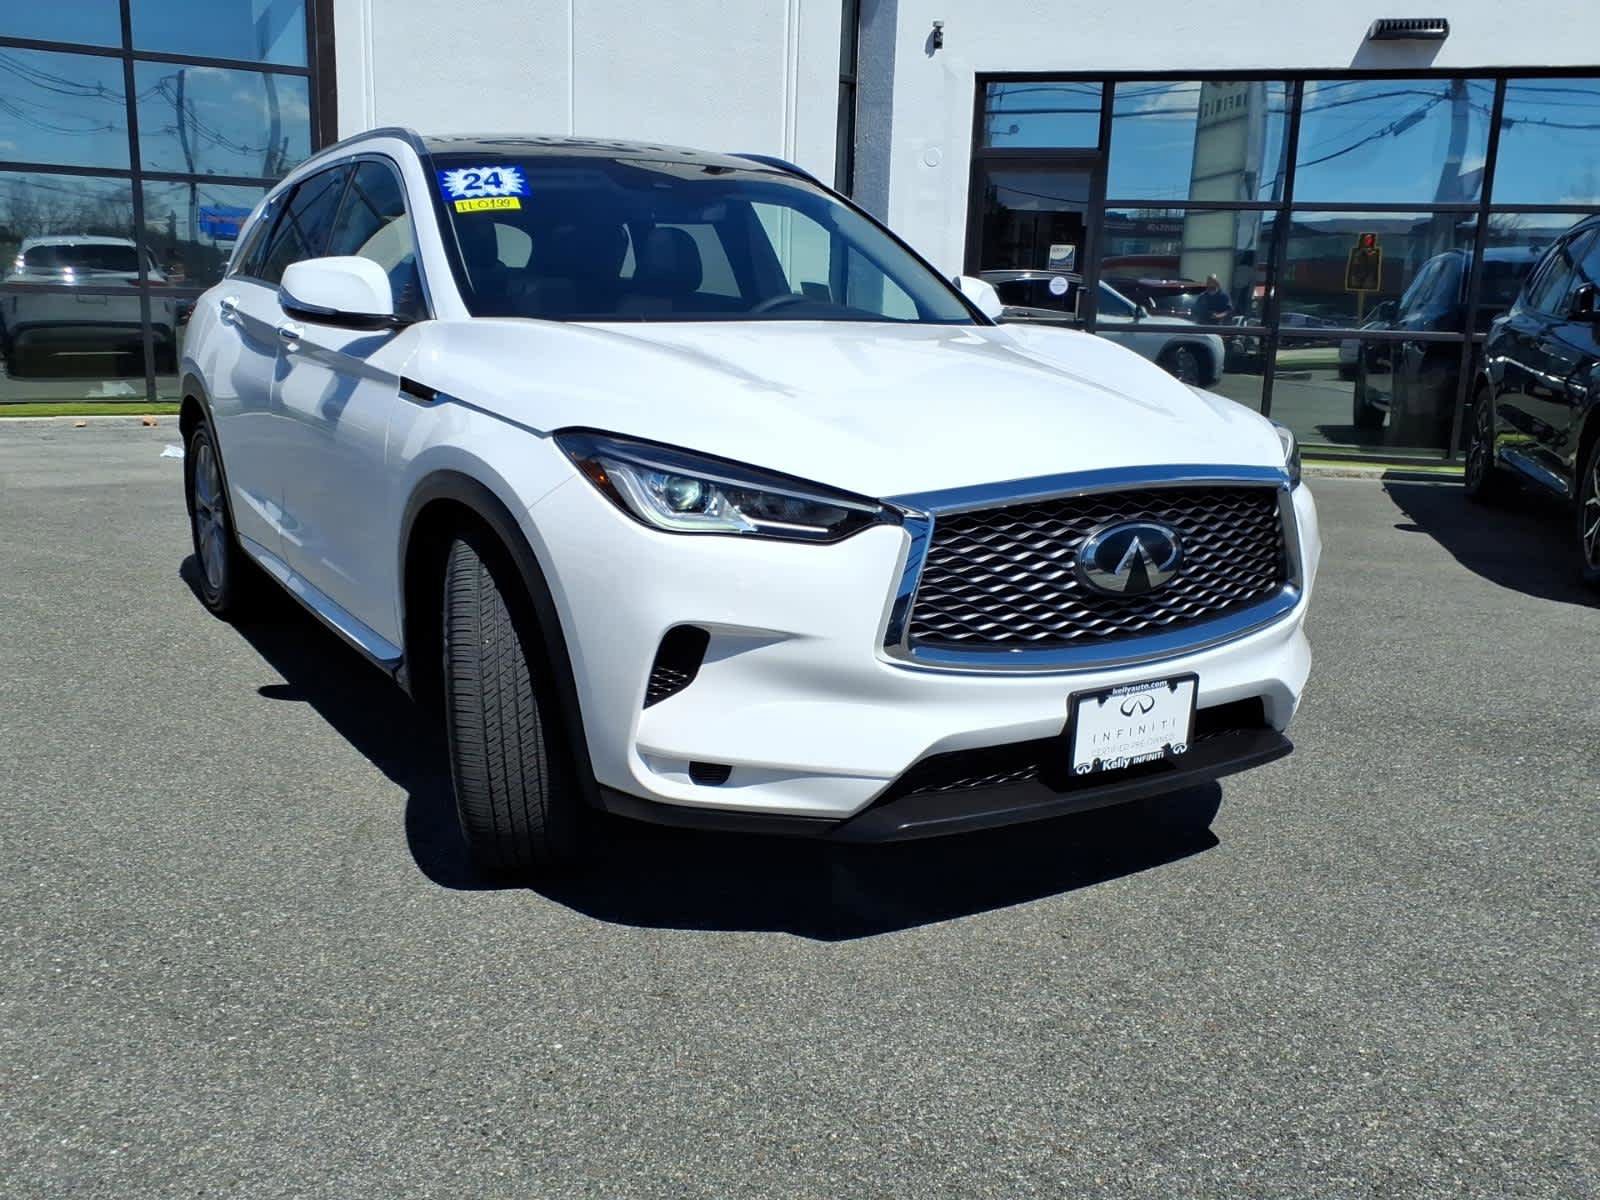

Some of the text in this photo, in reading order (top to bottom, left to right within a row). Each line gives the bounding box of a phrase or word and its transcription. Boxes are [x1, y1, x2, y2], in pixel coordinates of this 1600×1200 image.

[462, 172, 503, 191] 24
[1112, 680, 1168, 696] kellyauto.com
[1092, 719, 1176, 744] INFINITI
[1102, 751, 1165, 771] Kelly INFINITI
